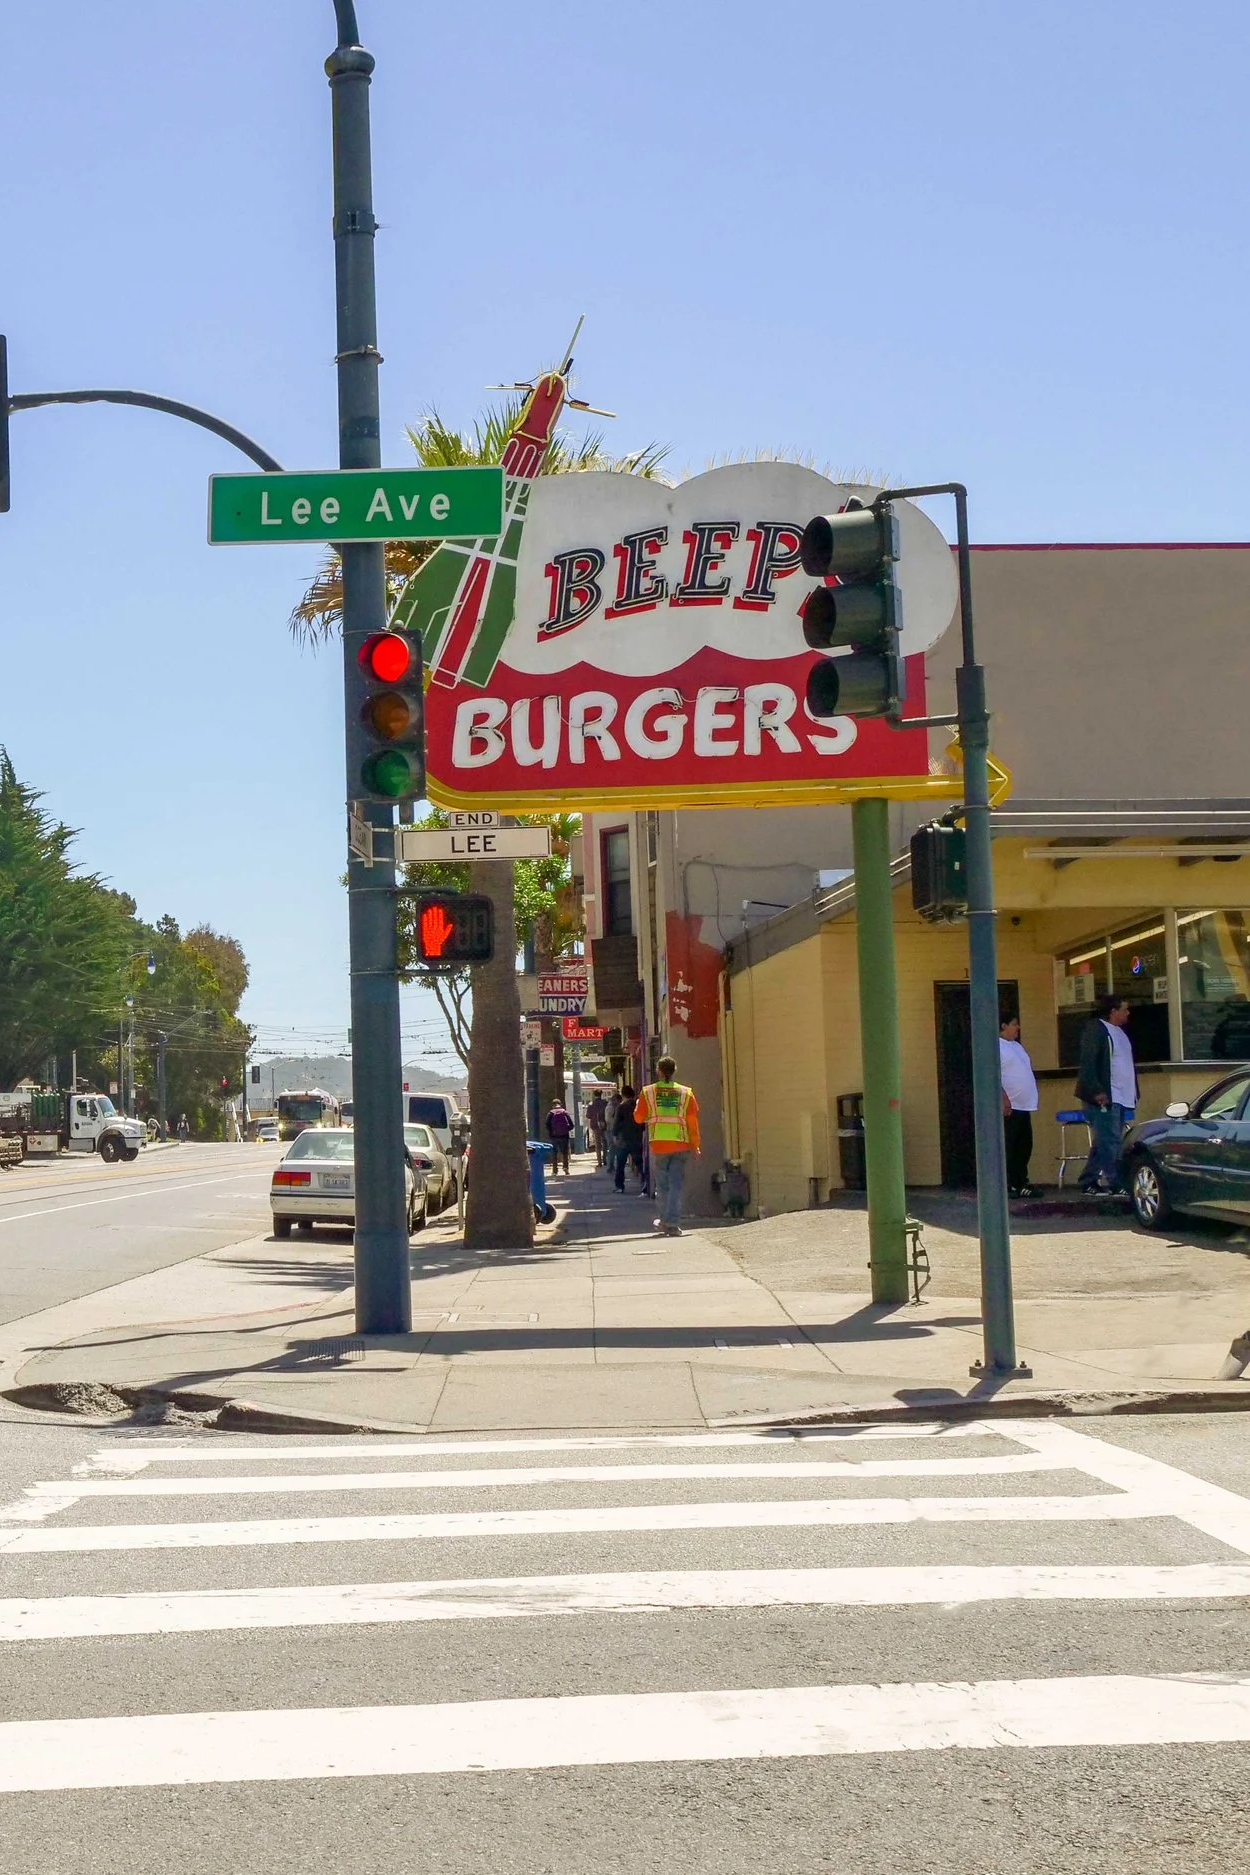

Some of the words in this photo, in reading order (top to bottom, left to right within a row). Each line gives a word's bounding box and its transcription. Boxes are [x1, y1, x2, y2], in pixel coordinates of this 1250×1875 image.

[260, 491, 341, 526] Lee
[365, 487, 451, 523] Ave
[537, 497, 864, 643] BEEP
[451, 682, 858, 769] BURGERS
[455, 812, 493, 826] END
[451, 834, 497, 854] LEE
[537, 979, 588, 992] EANERS
[539, 998, 586, 1012] UNDRY
[567, 1028, 604, 1038] MART
